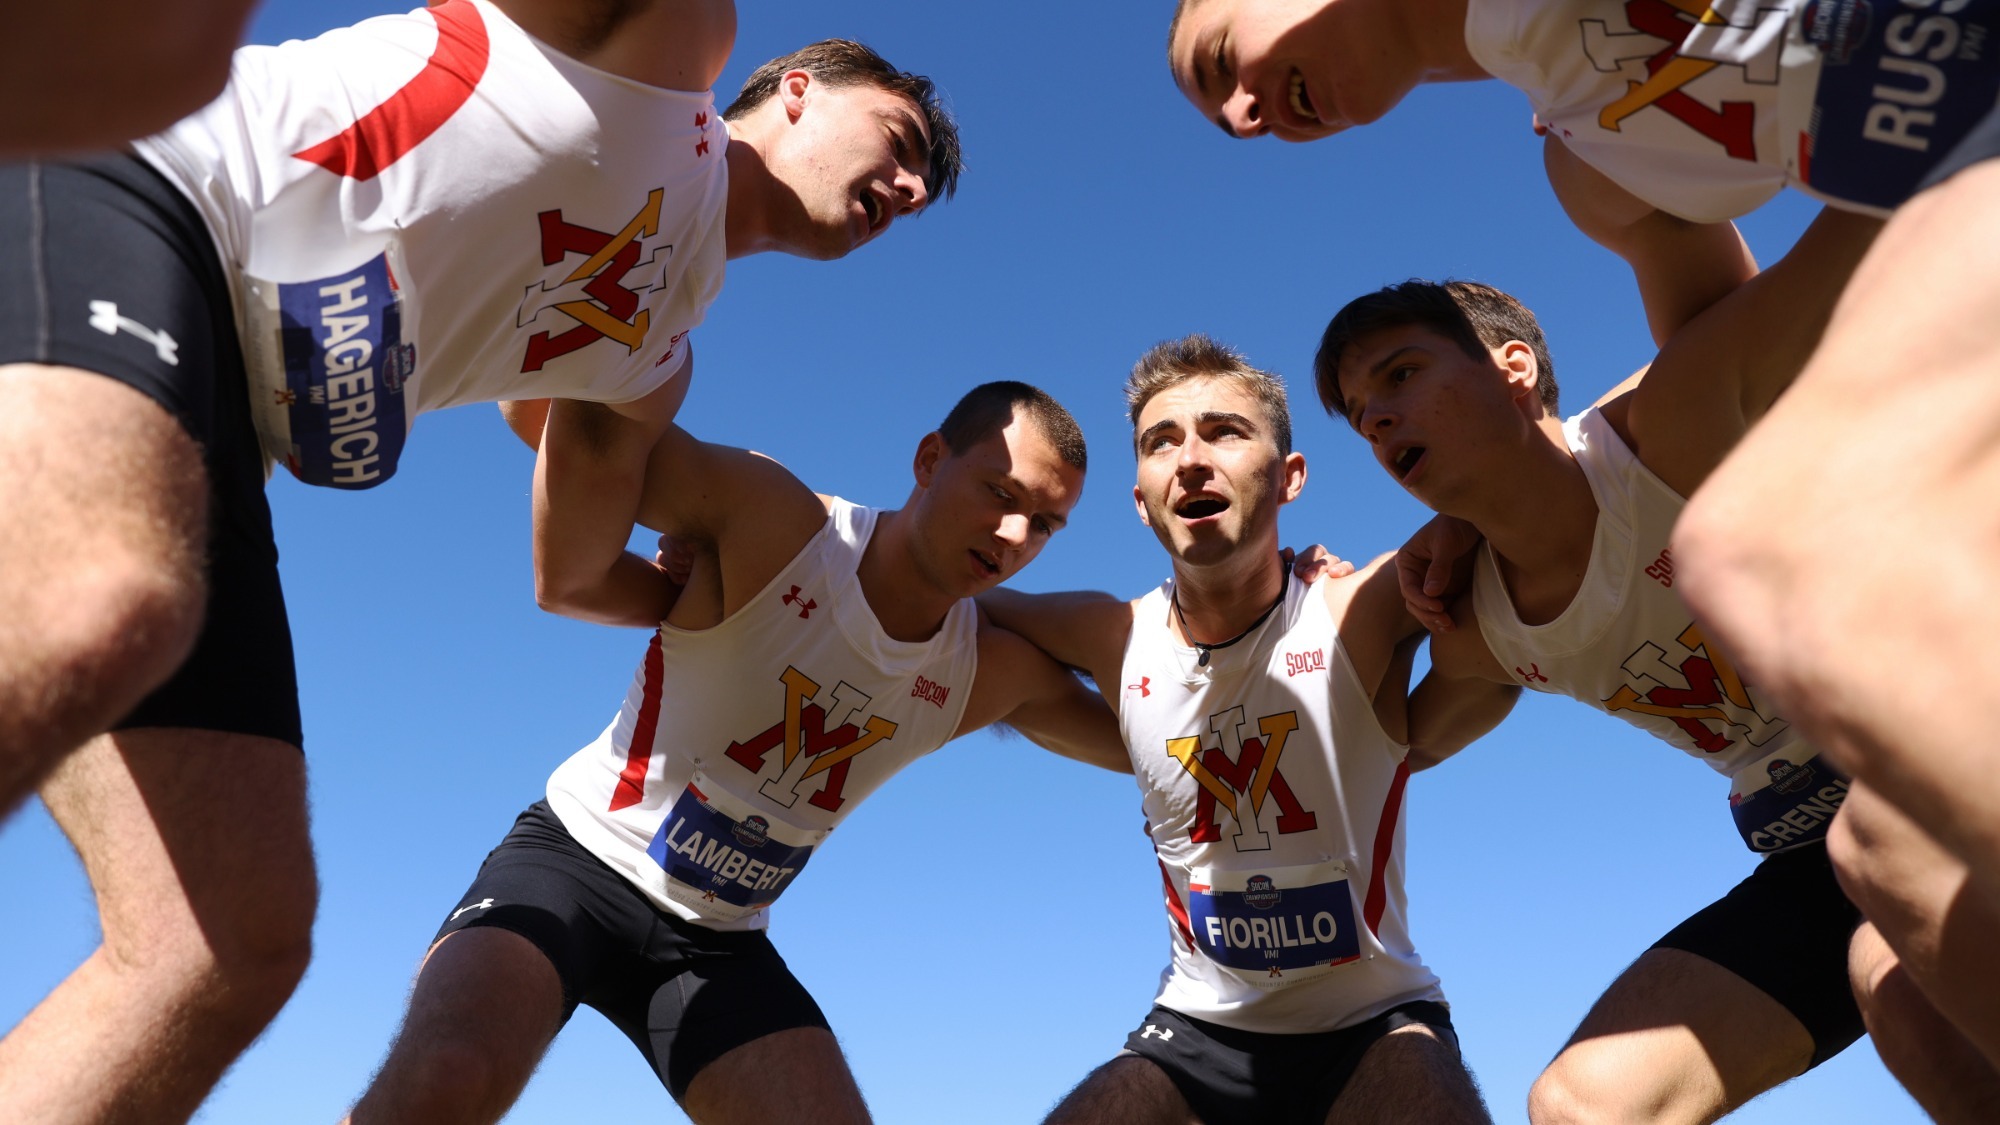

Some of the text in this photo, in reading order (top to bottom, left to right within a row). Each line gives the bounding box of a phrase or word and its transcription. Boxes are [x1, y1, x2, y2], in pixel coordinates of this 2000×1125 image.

[318, 275, 380, 483] HAGERICH
[310, 385, 326, 404] VMI
[665, 816, 795, 890] LAMBERT
[711, 874, 728, 887] VMI
[1205, 911, 1337, 949] FIORILLO
[1264, 949, 1279, 959] VMI
